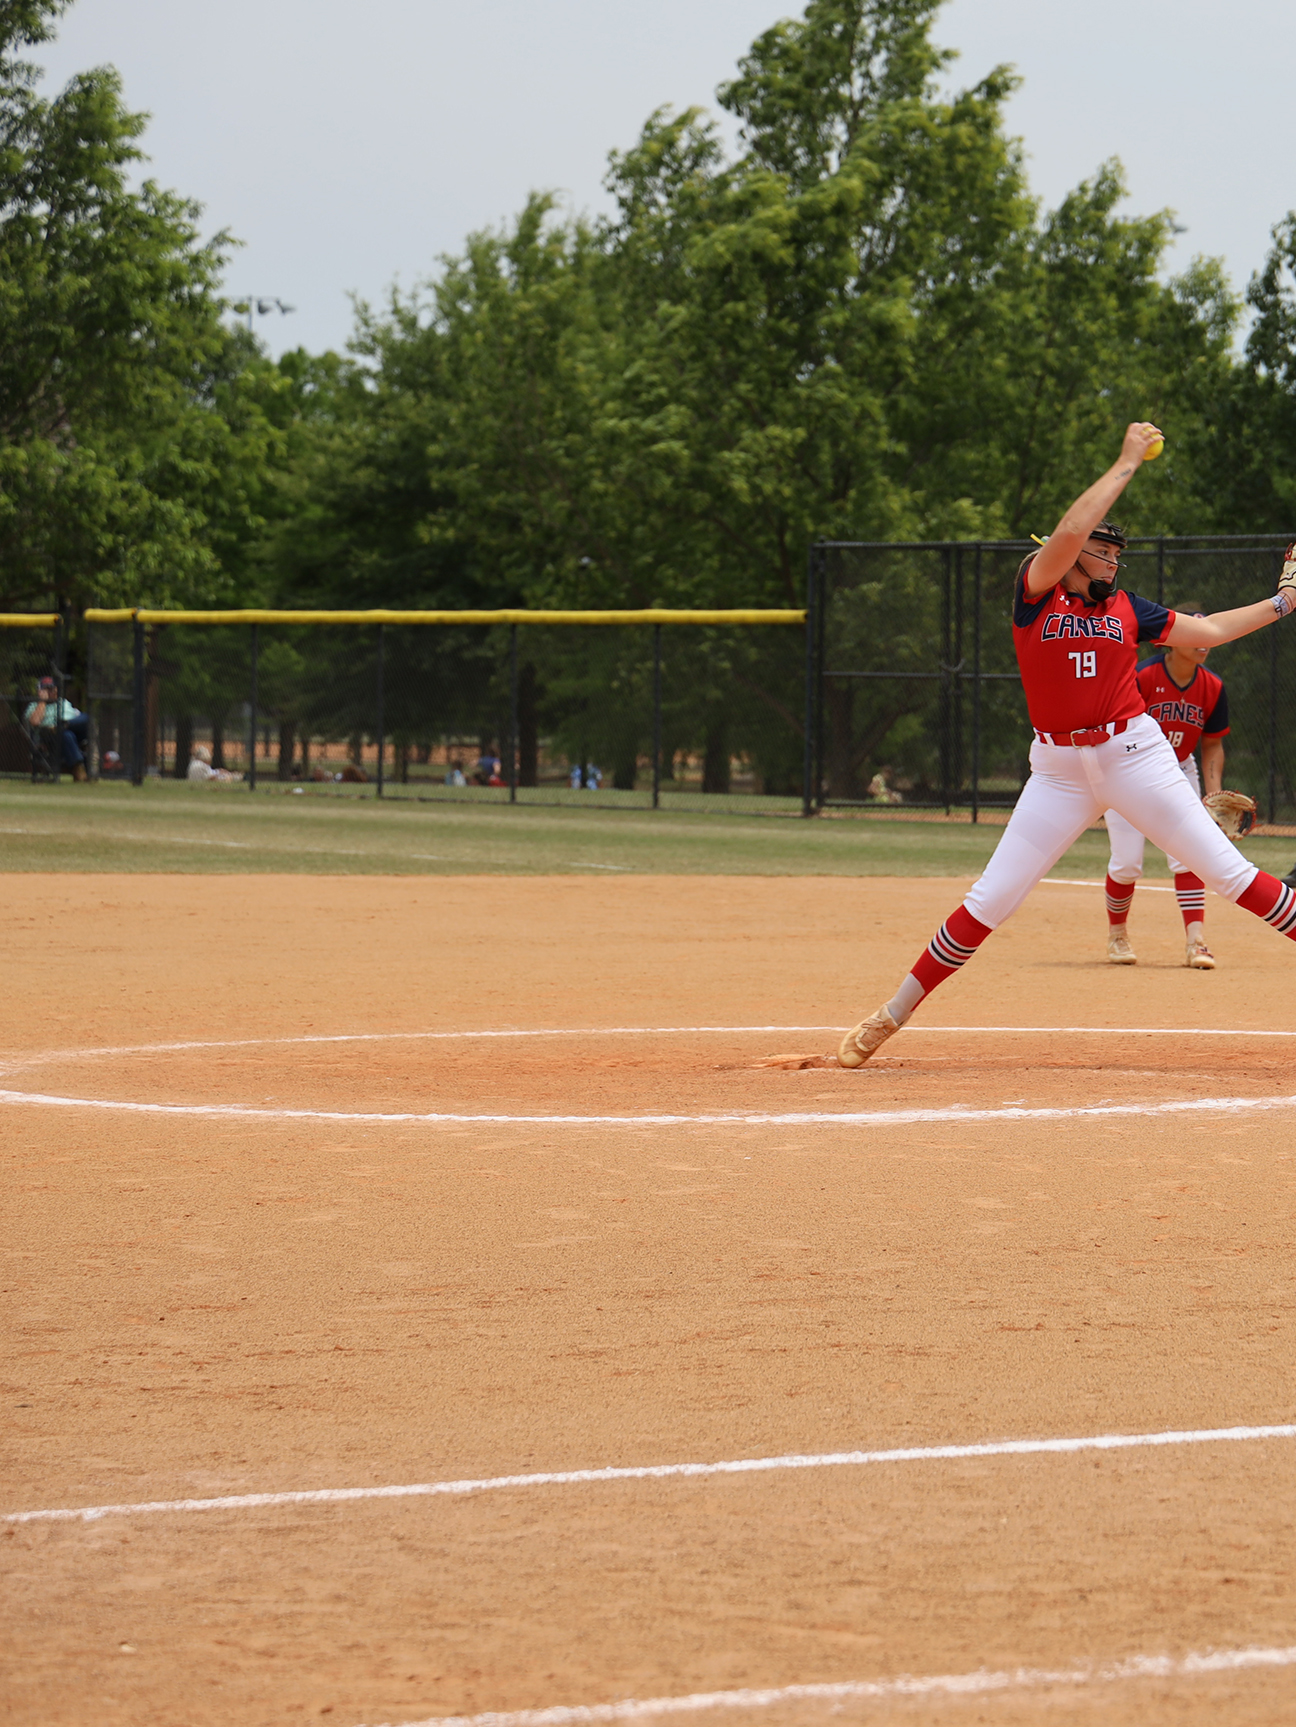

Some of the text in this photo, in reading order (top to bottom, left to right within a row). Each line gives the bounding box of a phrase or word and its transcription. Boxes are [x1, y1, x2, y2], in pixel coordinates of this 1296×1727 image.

[1041, 613, 1124, 644] CANES
[1068, 651, 1097, 678] 79
[1147, 701, 1204, 730] CANES
